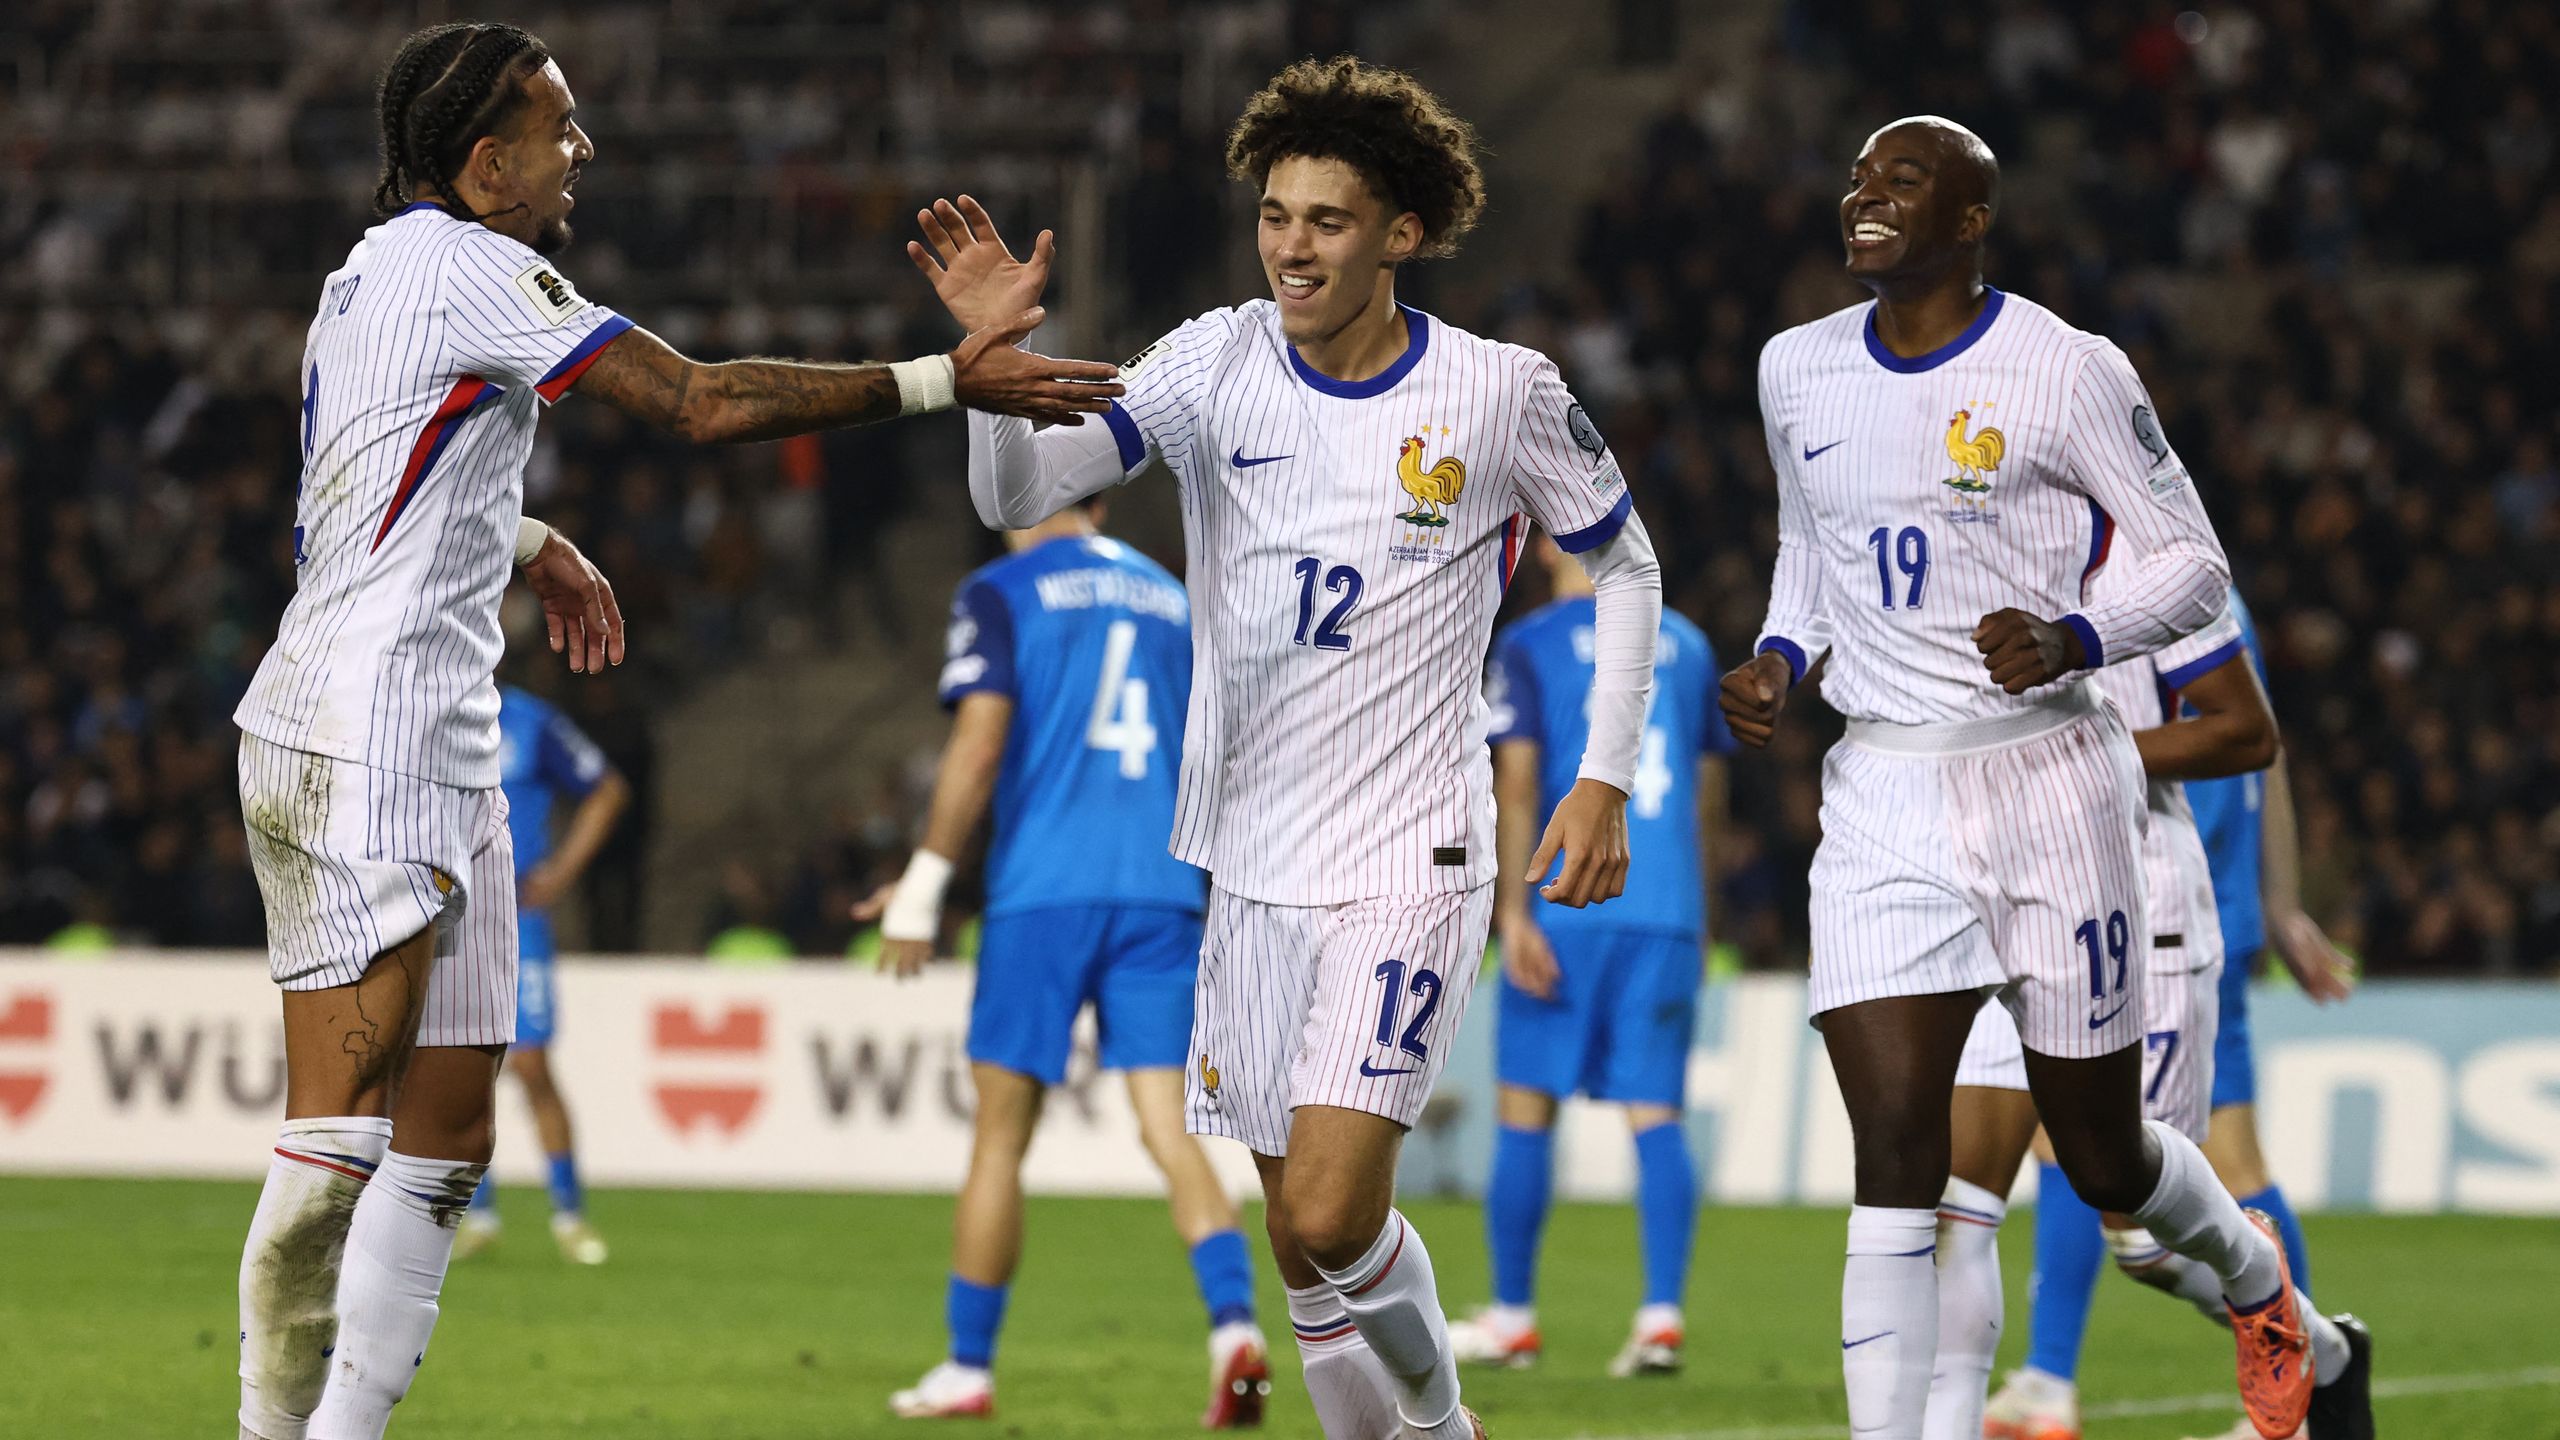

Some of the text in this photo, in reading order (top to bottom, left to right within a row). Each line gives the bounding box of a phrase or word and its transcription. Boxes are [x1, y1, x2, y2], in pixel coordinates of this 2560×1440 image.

[1294, 557, 1364, 651] 12
[1868, 526, 1931, 611] 19
[1086, 618, 1158, 780] 4
[2076, 909, 2128, 999] 19
[1376, 959, 1442, 1063] 12
